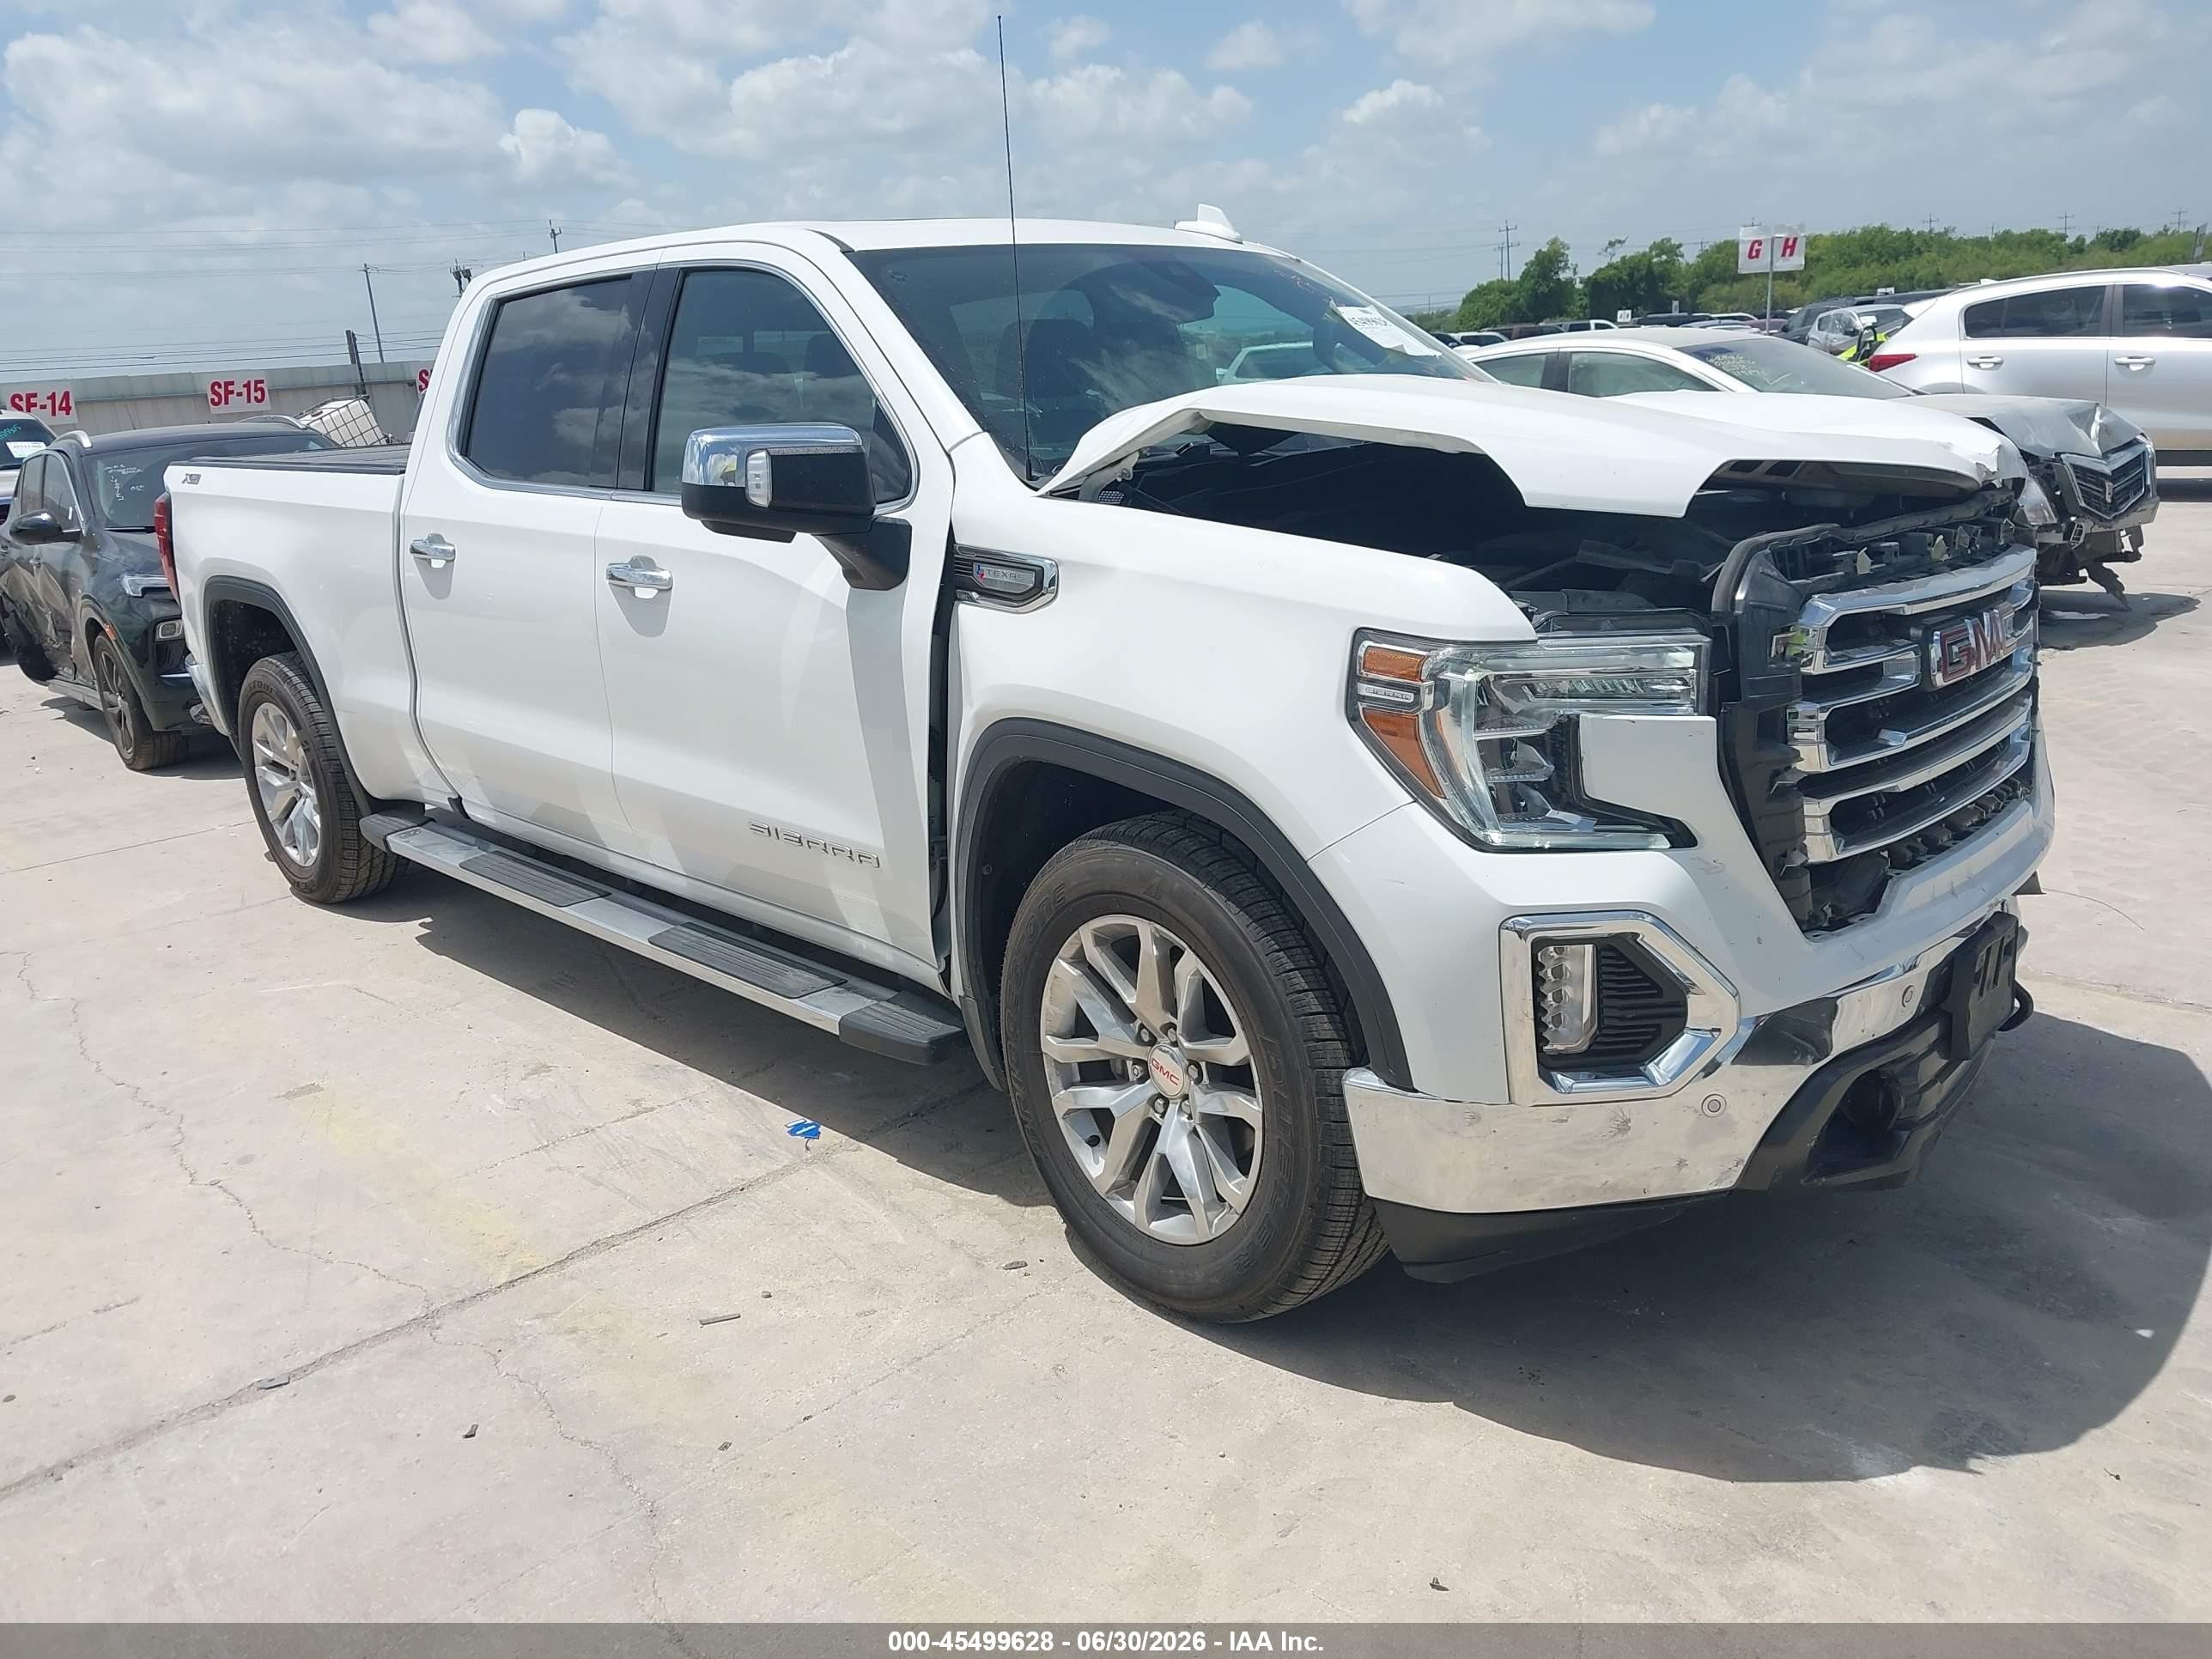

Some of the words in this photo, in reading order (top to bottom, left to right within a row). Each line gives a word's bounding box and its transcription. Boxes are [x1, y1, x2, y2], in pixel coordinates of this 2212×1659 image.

[1747, 239, 1763, 259] G
[1781, 237, 1798, 258] H
[10, 391, 71, 416] SF-14
[210, 379, 265, 406] SF-15
[986, 568, 1025, 581] TEXAS
[1935, 603, 2021, 684] GMC
[748, 819, 880, 868] SIERRA
[1152, 1057, 1180, 1086] GMC
